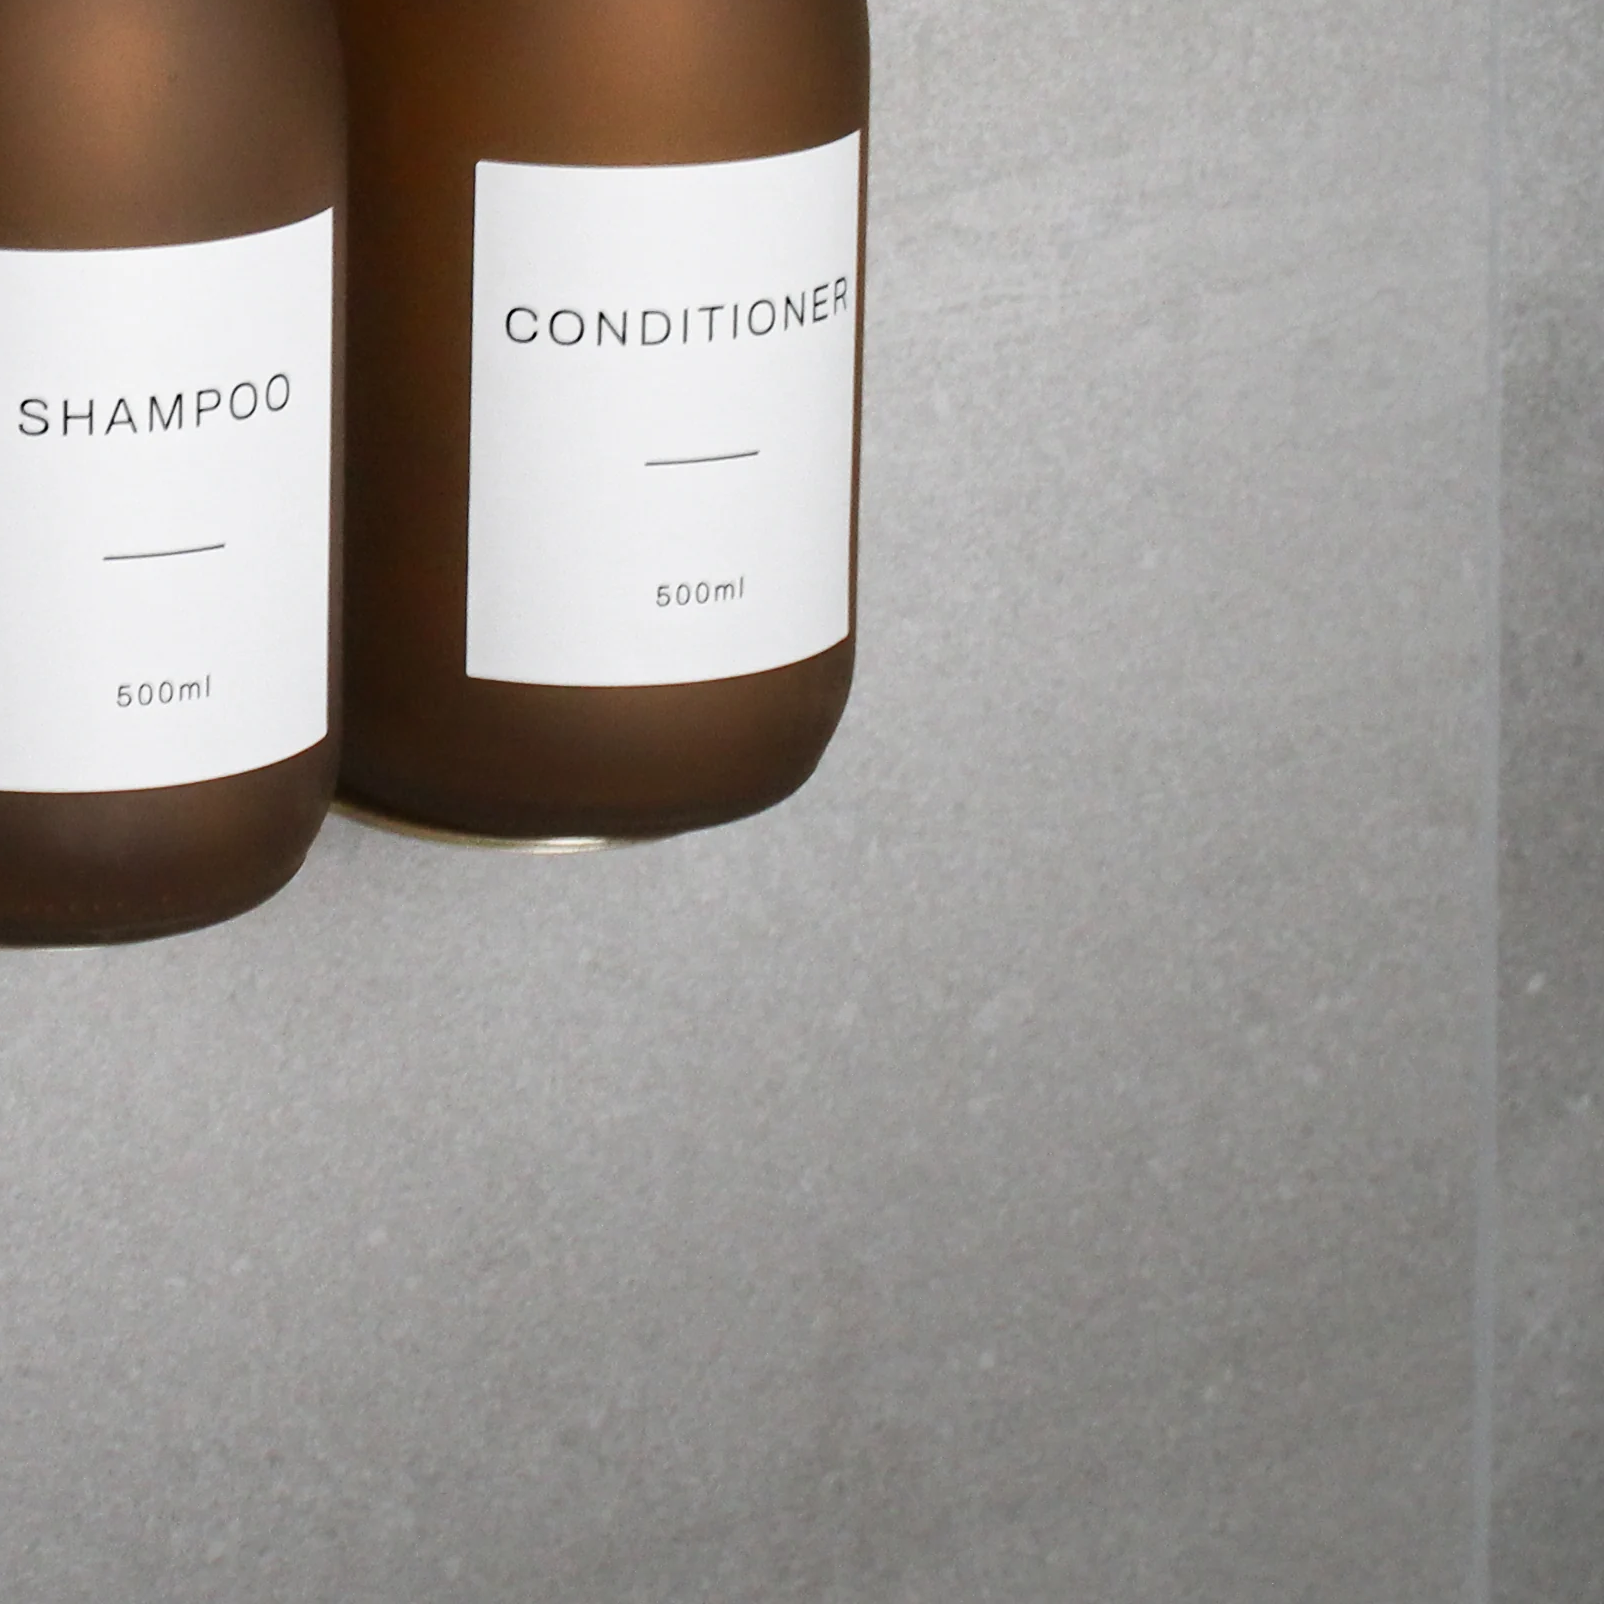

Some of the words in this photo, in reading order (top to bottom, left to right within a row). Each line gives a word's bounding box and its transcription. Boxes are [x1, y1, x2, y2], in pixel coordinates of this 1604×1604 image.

[503, 274, 850, 348] CONDITIONER
[16, 371, 293, 438] SHAMPOO
[654, 575, 745, 609] 500ml
[115, 673, 211, 709] 500ml
